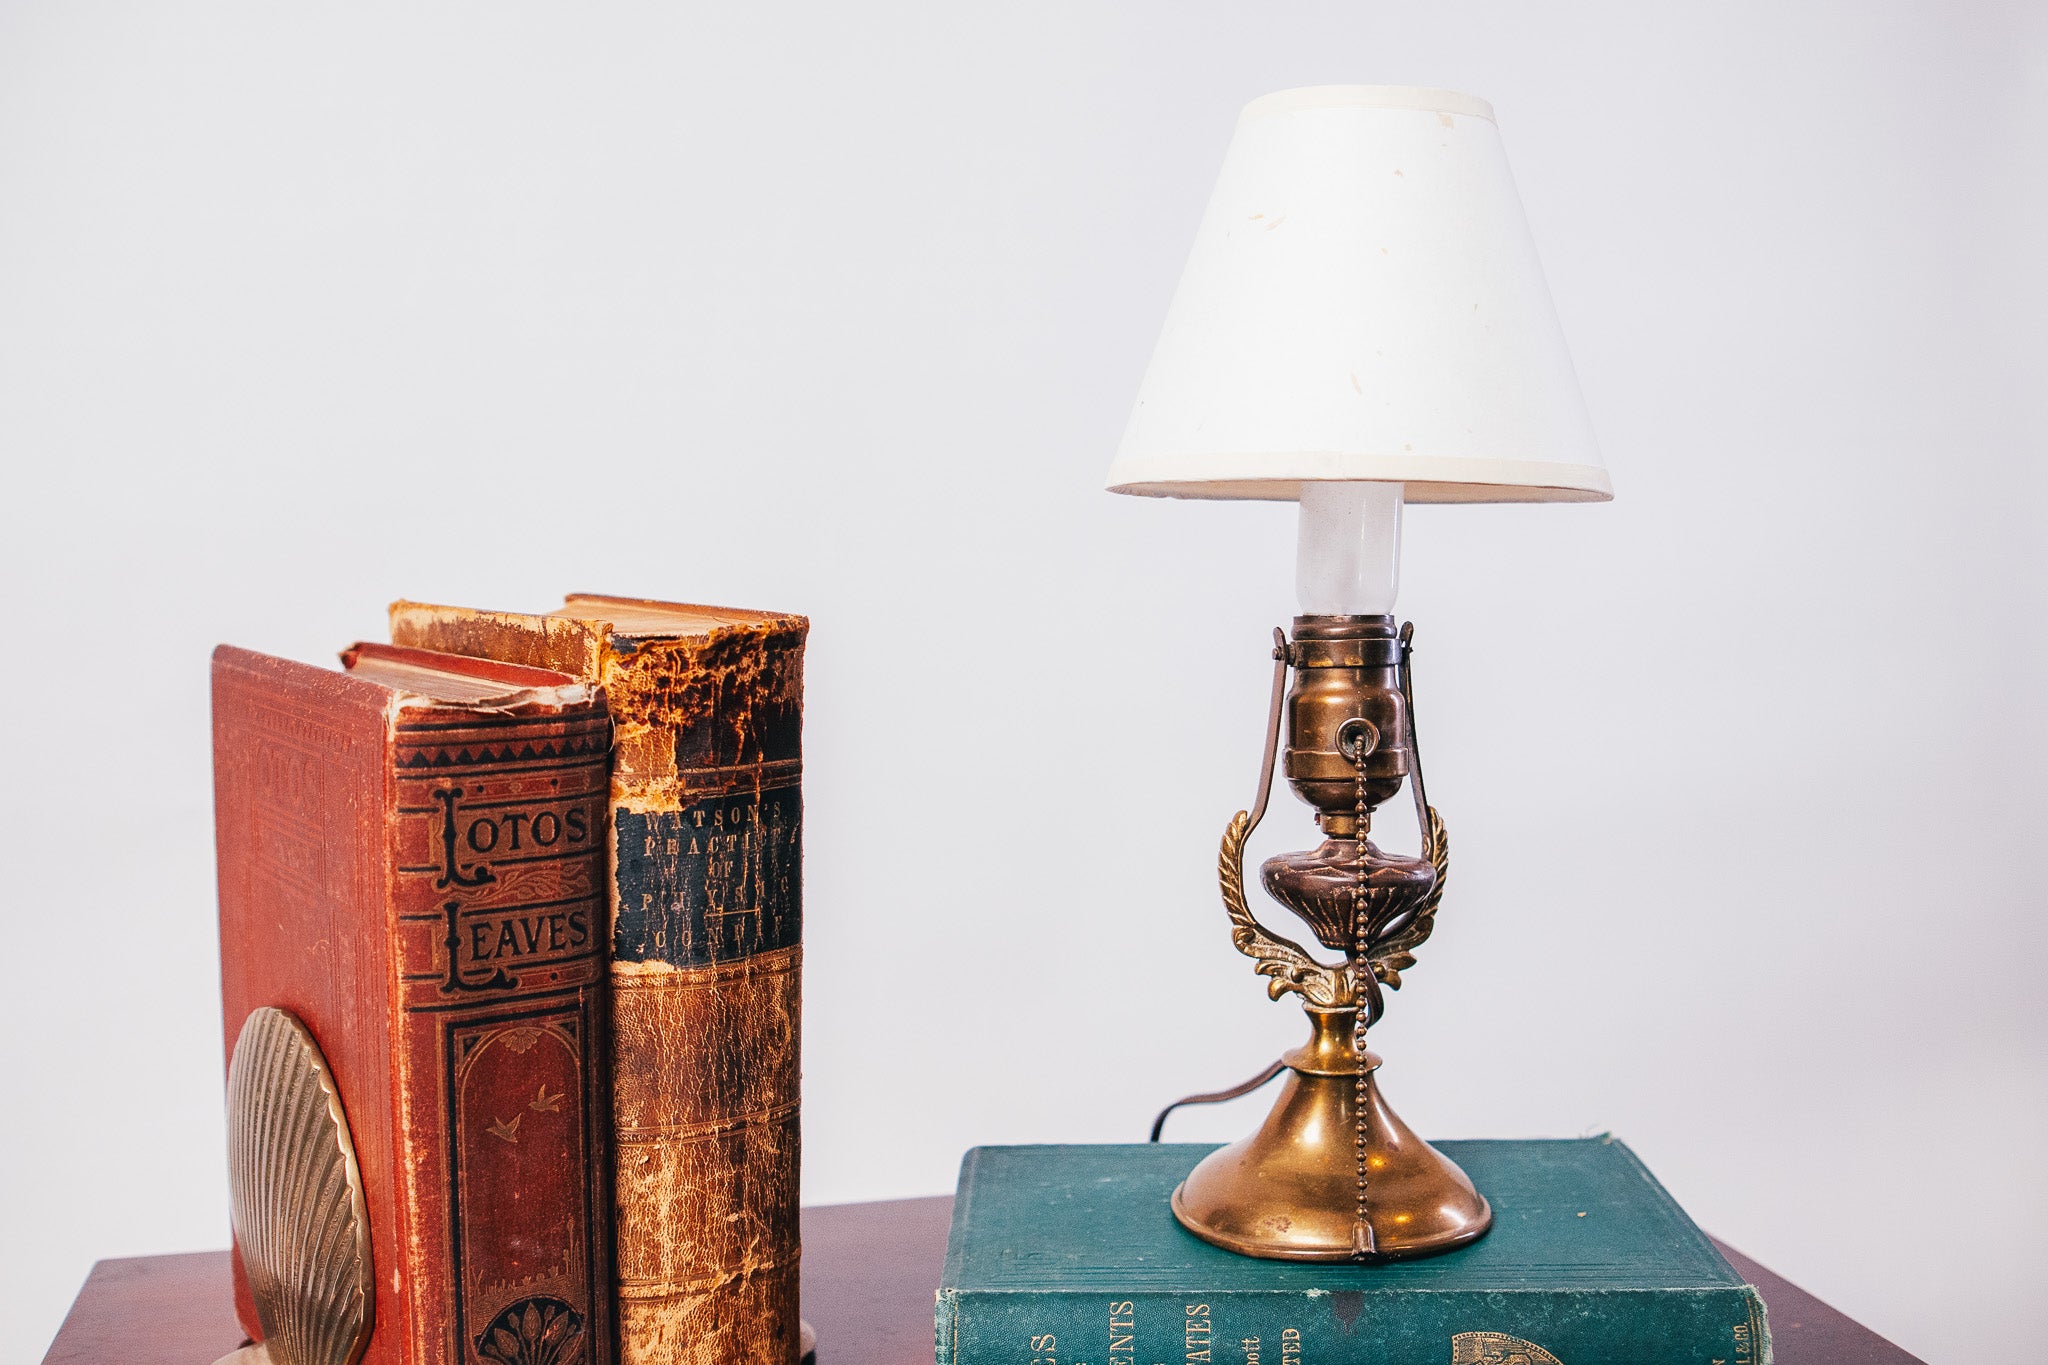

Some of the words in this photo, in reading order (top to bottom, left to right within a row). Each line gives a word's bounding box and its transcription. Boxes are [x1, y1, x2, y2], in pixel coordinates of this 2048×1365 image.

[434, 789, 588, 889] LOTOS
[713, 861, 733, 879] OF
[441, 902, 589, 993] LEAVES
[1185, 1304, 1211, 1365] ATES
